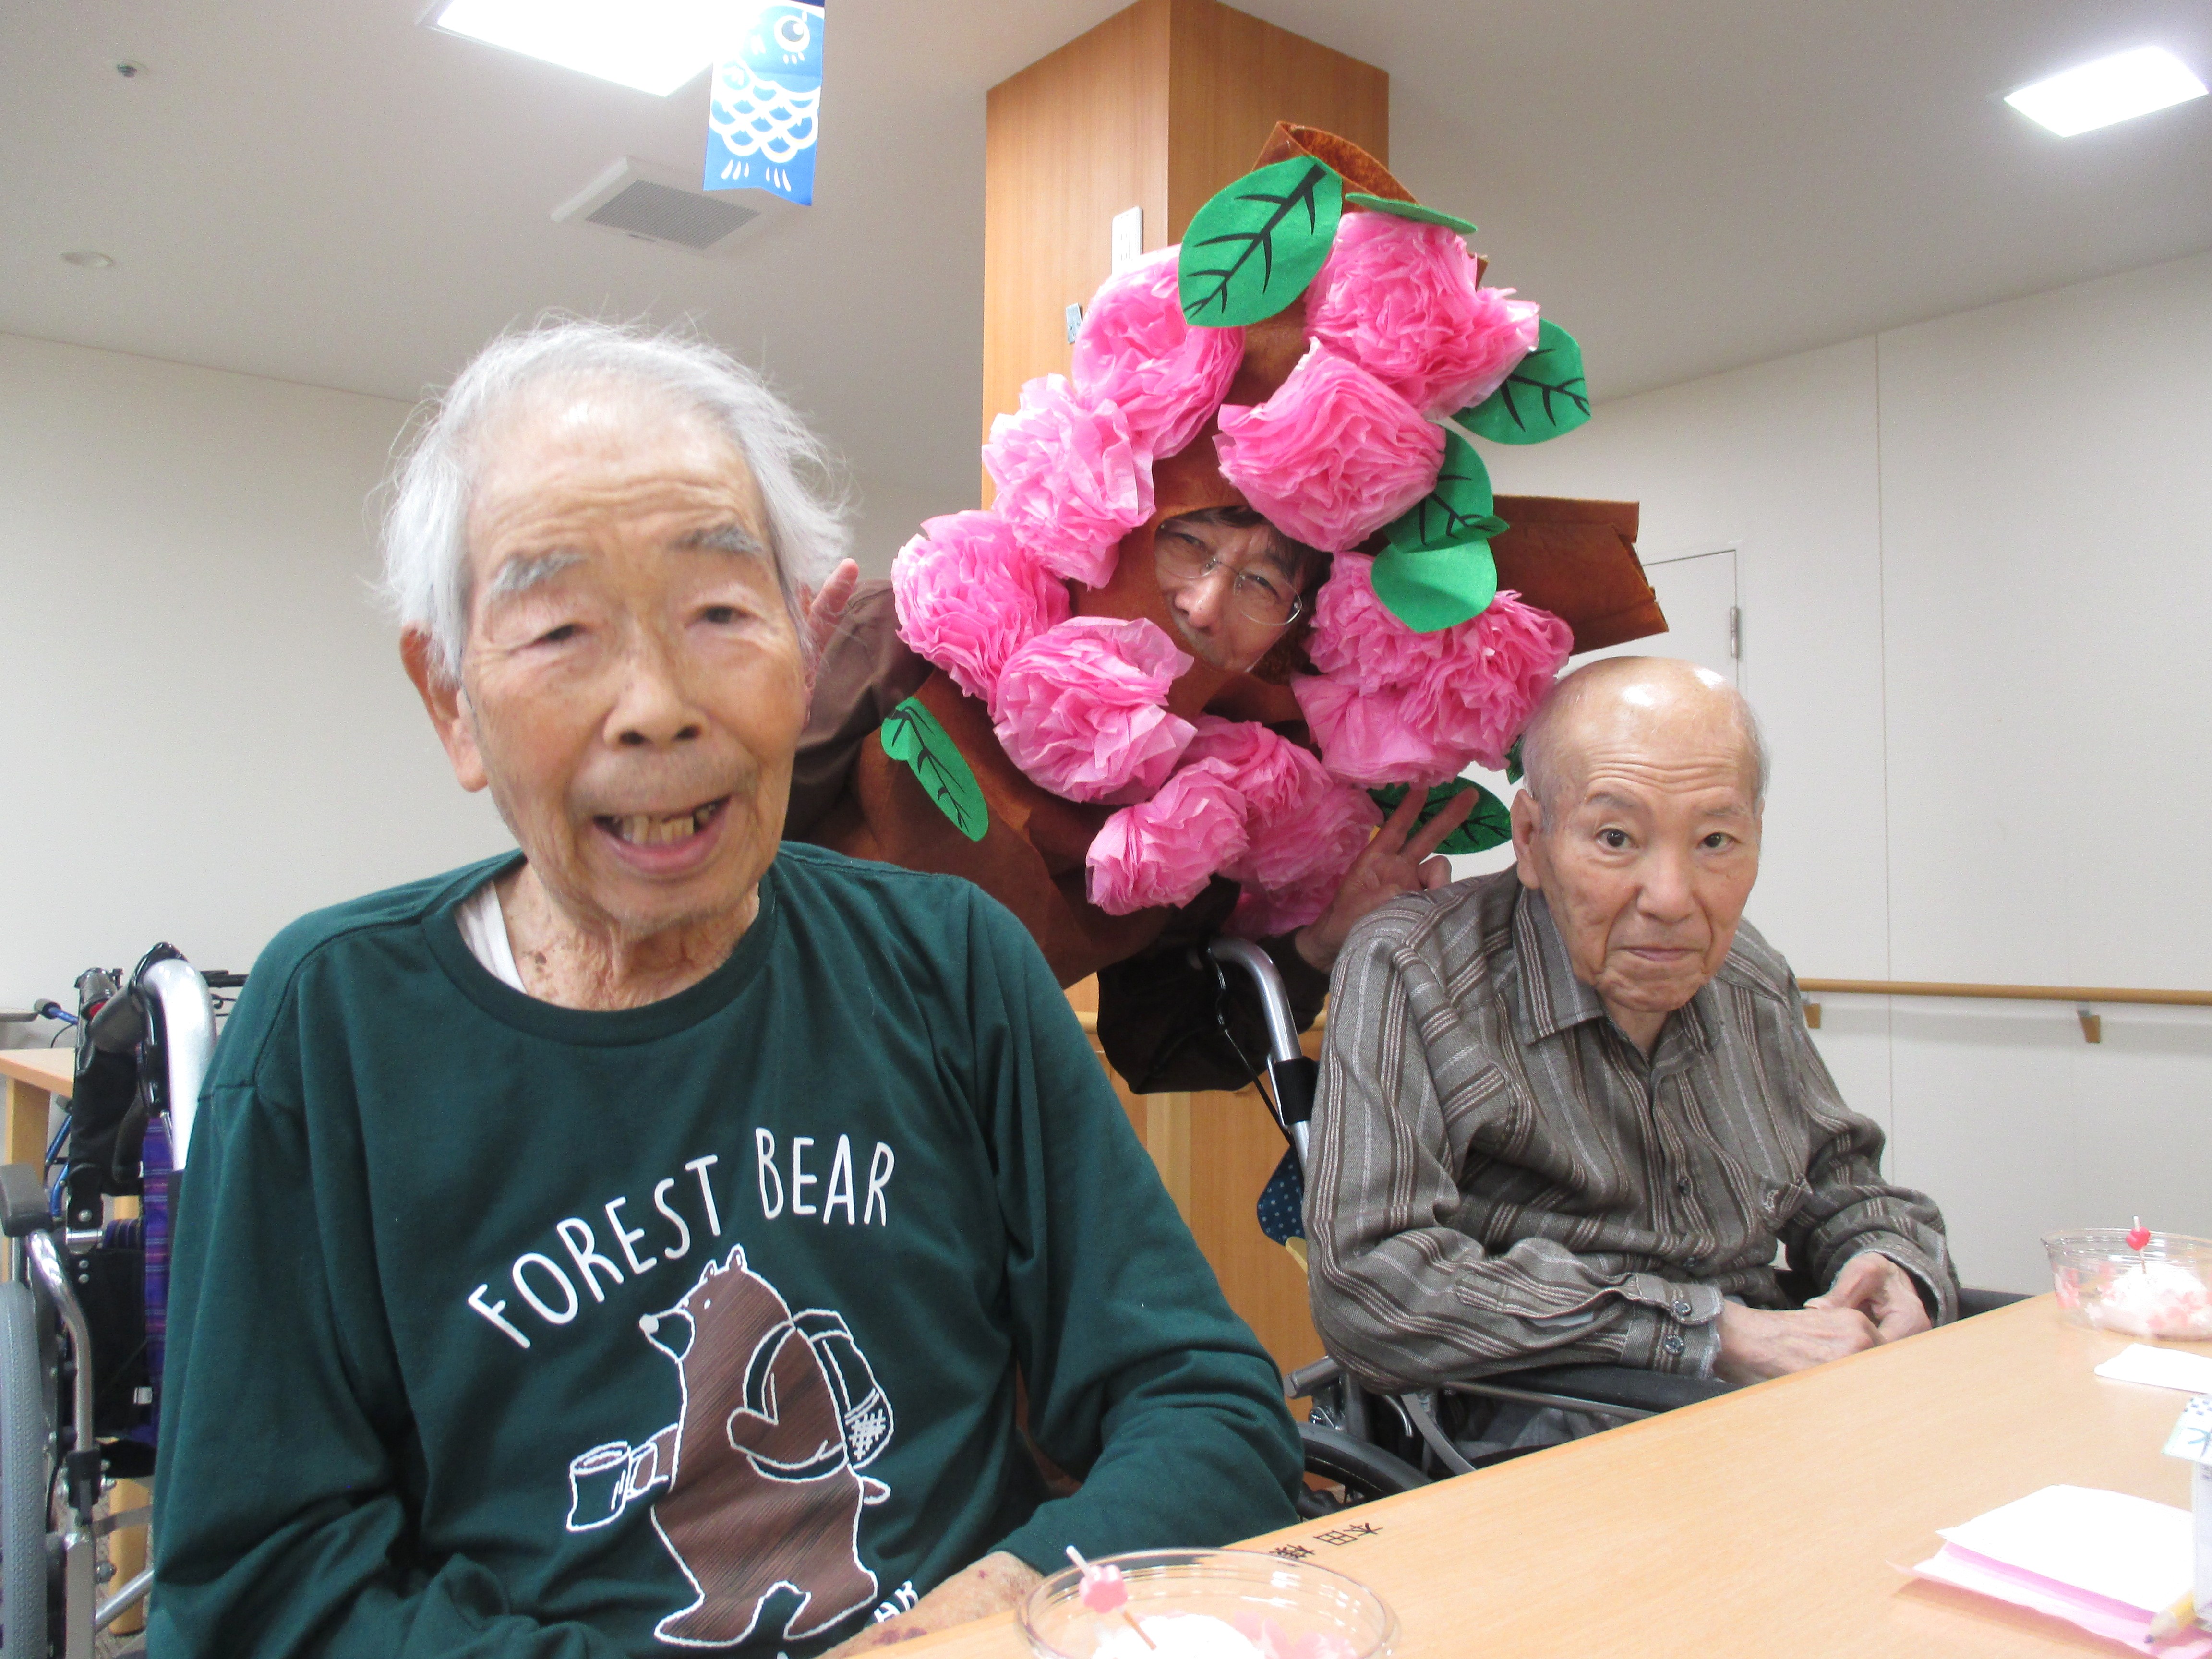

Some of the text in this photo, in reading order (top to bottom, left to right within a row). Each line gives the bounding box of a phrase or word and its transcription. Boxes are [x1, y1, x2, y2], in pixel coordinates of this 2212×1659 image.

[468, 1127, 894, 1348] FOREST BEAR
[1313, 1522, 1383, 1546] 本田
